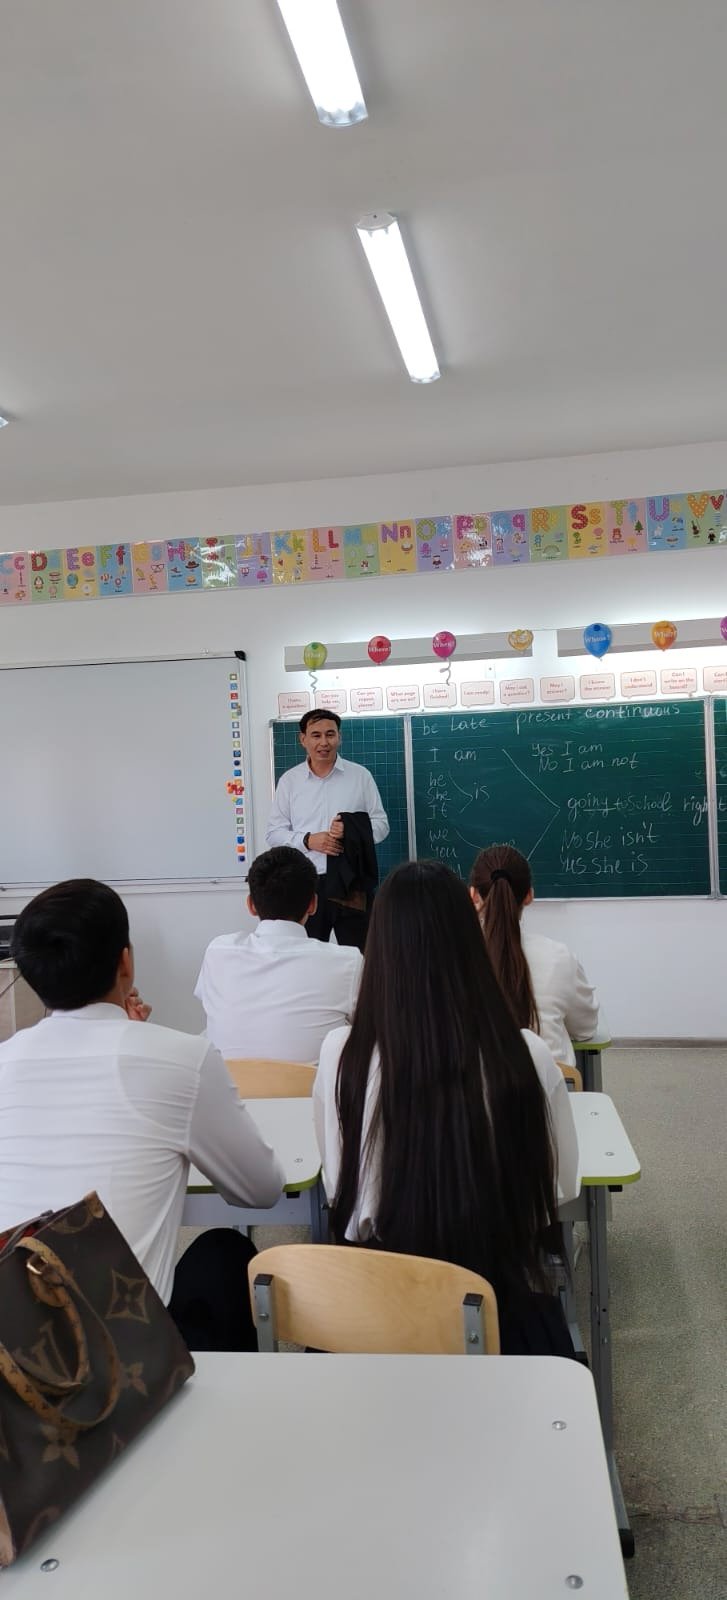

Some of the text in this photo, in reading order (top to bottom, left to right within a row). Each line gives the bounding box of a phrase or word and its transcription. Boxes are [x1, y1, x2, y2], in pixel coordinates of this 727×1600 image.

[382, 522, 411, 543] Nn
[571, 504, 601, 530] Ss
[585, 704, 680, 719] continuous
[429, 748, 477, 763] I am
[560, 741, 574, 756] I
[578, 743, 603, 754] am
[538, 752, 640, 773] No I am not
